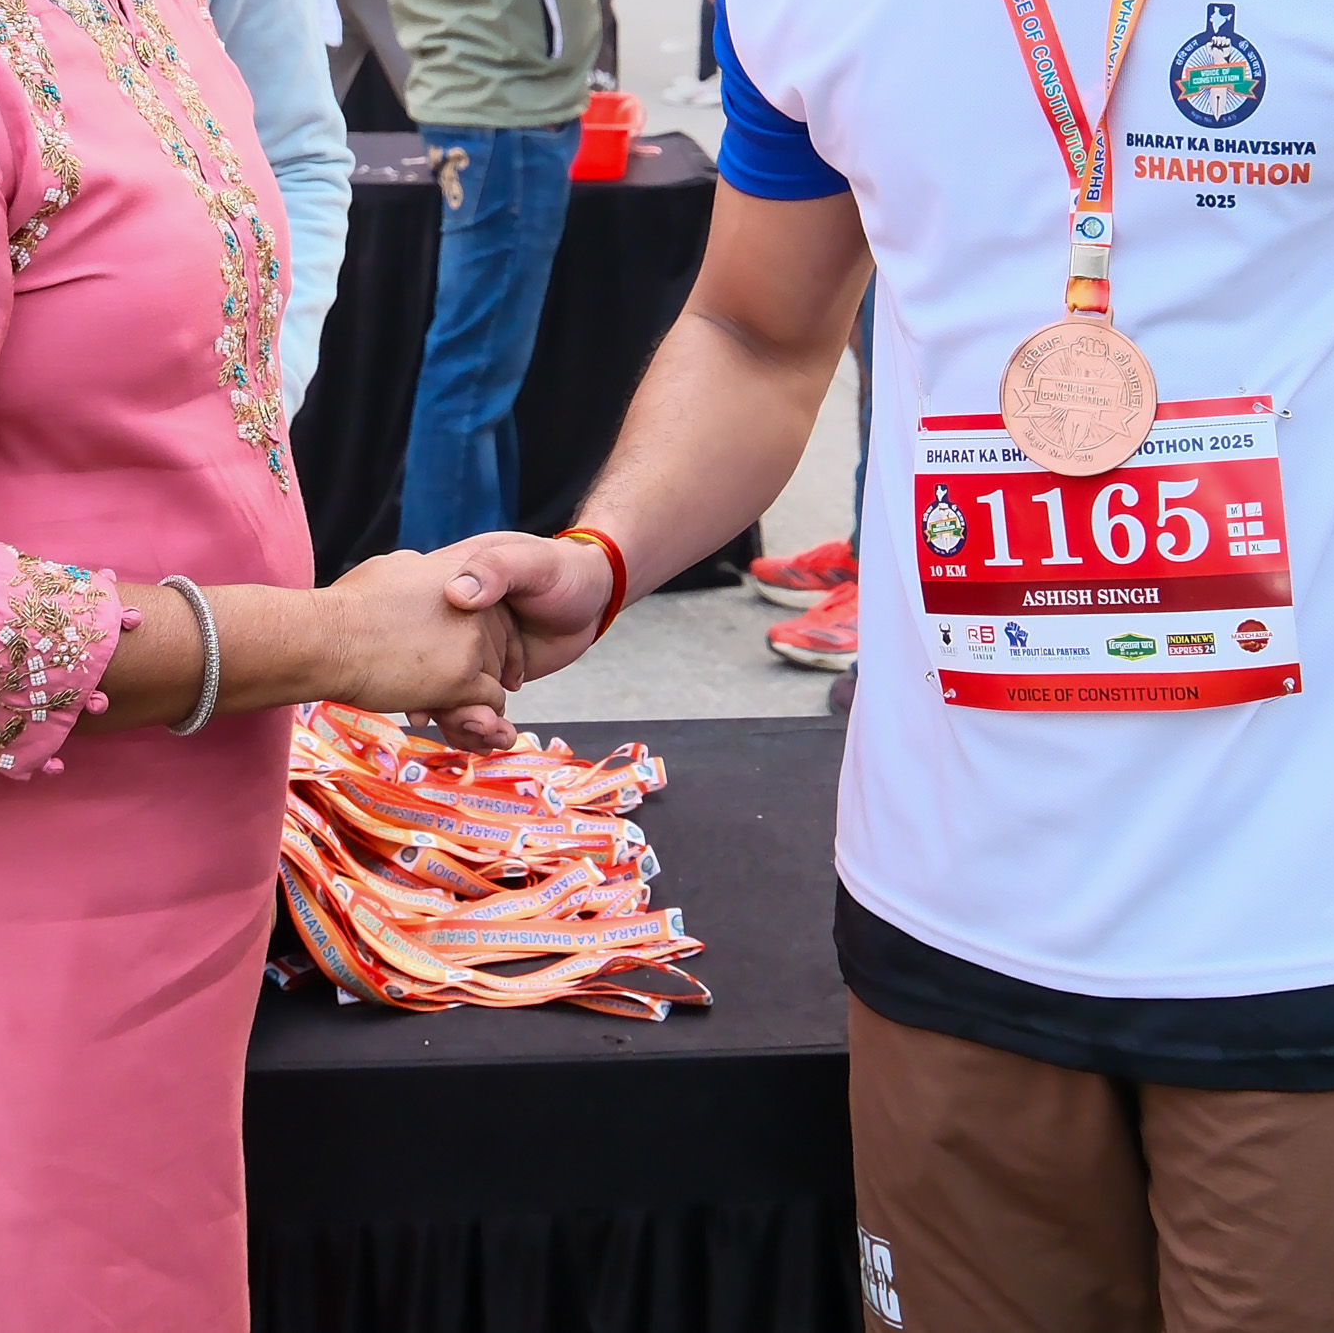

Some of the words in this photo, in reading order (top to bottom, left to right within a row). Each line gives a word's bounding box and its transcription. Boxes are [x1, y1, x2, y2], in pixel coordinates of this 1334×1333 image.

[1021, 14, 1046, 42] OF
[1192, 74, 1240, 85] CONSTITUTION
[1200, 68, 1220, 77] VOICE
[1031, 44, 1088, 178] CONSTITUTION
[1126, 132, 1185, 150] BHARAT
[1187, 137, 1210, 152] KA
[1214, 138, 1317, 155] BHAVISHYA
[1134, 155, 1311, 186] SHAHOTHON
[1195, 193, 1236, 209] 2025
[1055, 382, 1085, 394] VOICE
[1087, 385, 1099, 395] OF
[1041, 390, 1112, 406] CONSTITUTION
[926, 448, 976, 464] BHARAT
[979, 447, 999, 463] KA
[1133, 437, 1204, 456] OTHON
[1209, 433, 1255, 451] 2025
[976, 478, 1210, 566] 1165
[1251, 543, 1261, 552] XL
[929, 565, 943, 577] 10
[945, 564, 967, 578] KM
[1022, 588, 1094, 607] ASHISH
[1097, 587, 1160, 606] SINGH
[1168, 635, 1189, 644] INDIA
[1190, 634, 1214, 643] NEWS
[1231, 632, 1254, 640] MATCH
[1009, 648, 1021, 656] THE
[1056, 647, 1090, 656] PARTNERS
[1169, 645, 1203, 655] EXPRESS
[1204, 644, 1215, 654] 24
[1007, 687, 1051, 702] VOICE
[1054, 687, 1074, 702] OF
[1078, 685, 1199, 701] CONSTITUTION
[436, 817, 455, 830] KA
[456, 822, 510, 841] BHARAT
[425, 858, 465, 886] VOICE
[538, 867, 588, 907] BHARAT
[481, 929, 573, 946] BHAVISHAYA
[577, 931, 596, 945] KA
[601, 921, 661, 946] BHARAT
